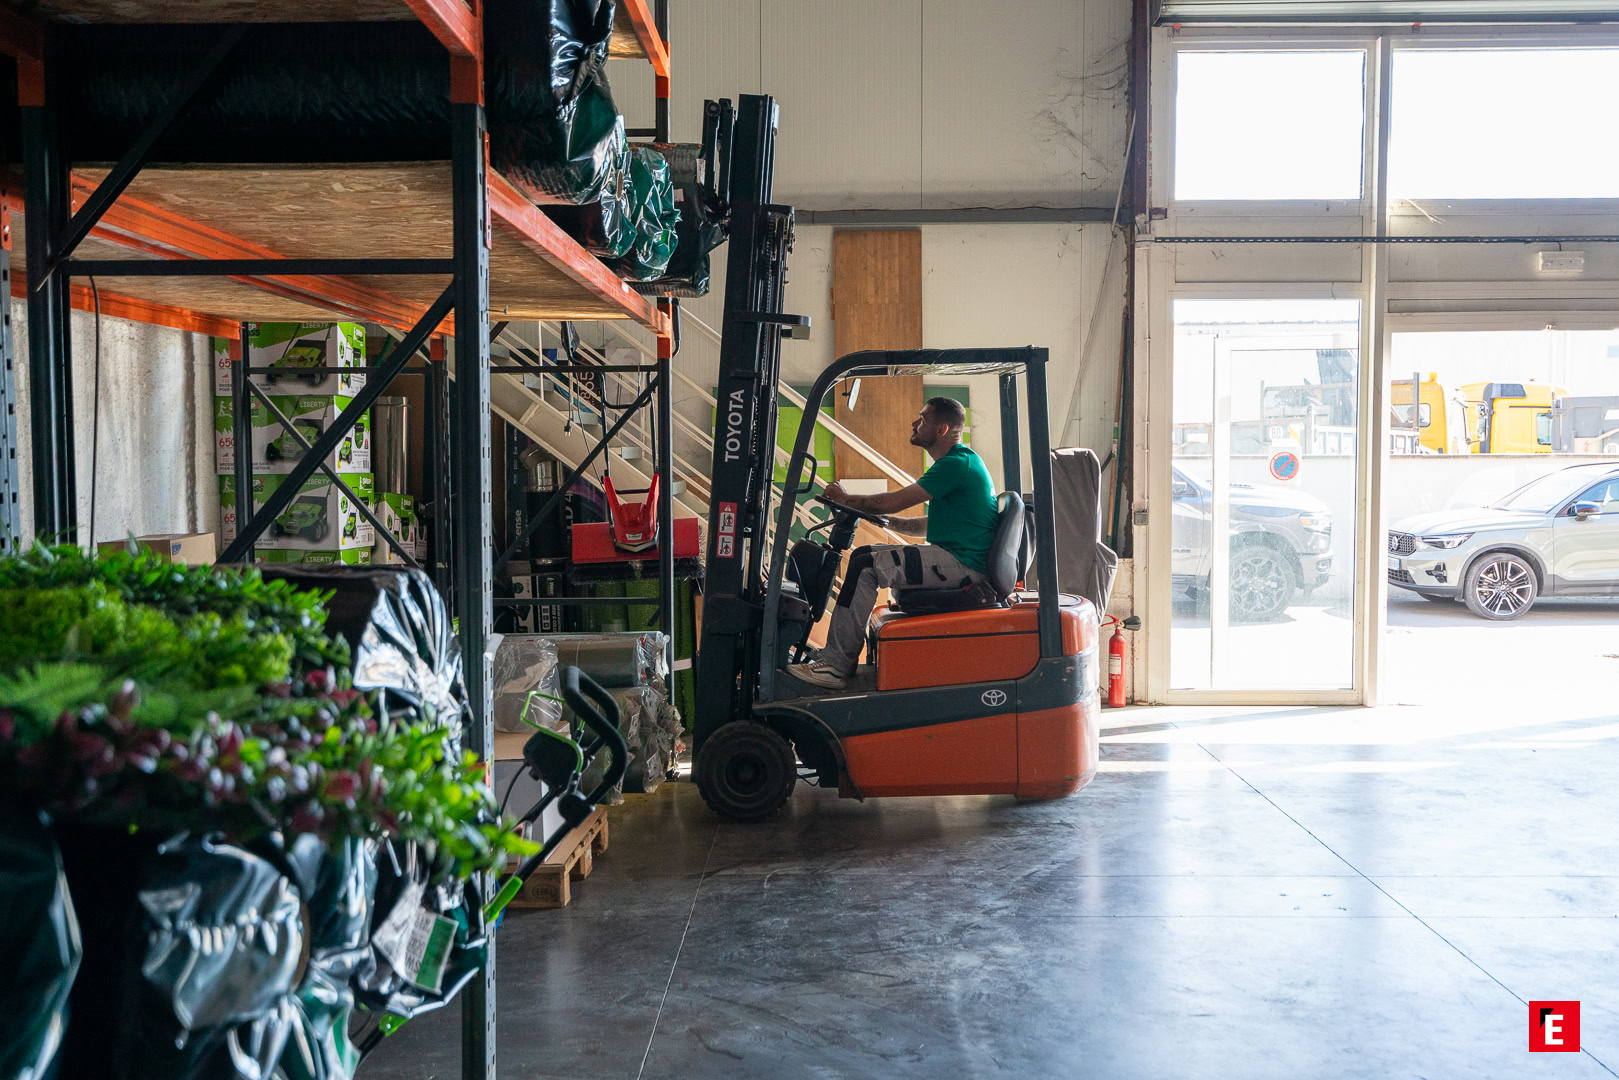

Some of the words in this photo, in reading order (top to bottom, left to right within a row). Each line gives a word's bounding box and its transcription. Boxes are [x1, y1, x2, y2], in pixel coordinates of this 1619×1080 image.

[302, 321, 329, 329] LIBERTY
[724, 389, 745, 463] TOYOTA
[305, 478, 329, 486] IBERTY
[305, 556, 333, 564] LIBERTY
